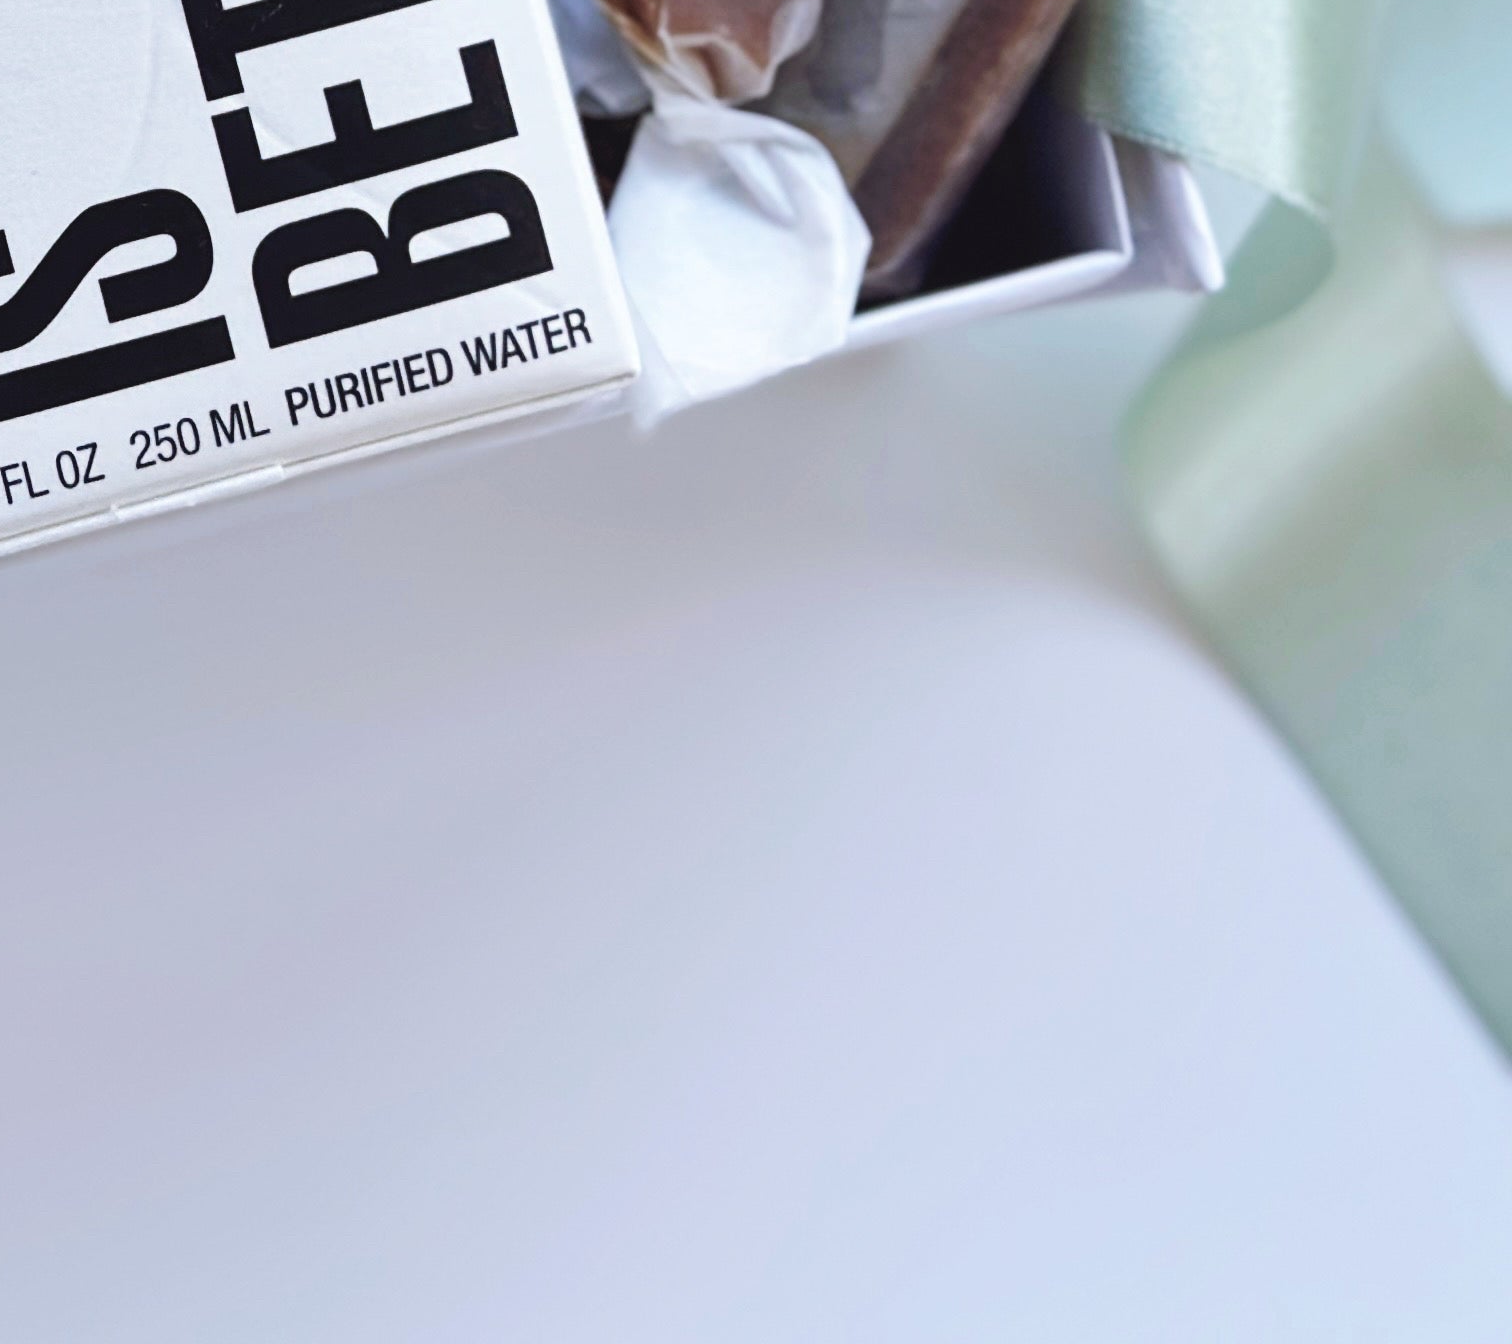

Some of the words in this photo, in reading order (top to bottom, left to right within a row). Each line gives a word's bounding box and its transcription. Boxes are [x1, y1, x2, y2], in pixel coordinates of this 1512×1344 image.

[0, 461, 49, 505] FL
[55, 443, 106, 489] OZ
[129, 417, 201, 469] 250
[209, 401, 270, 449] ML
[284, 348, 454, 426] PURIFIED
[461, 308, 593, 377] WATER
